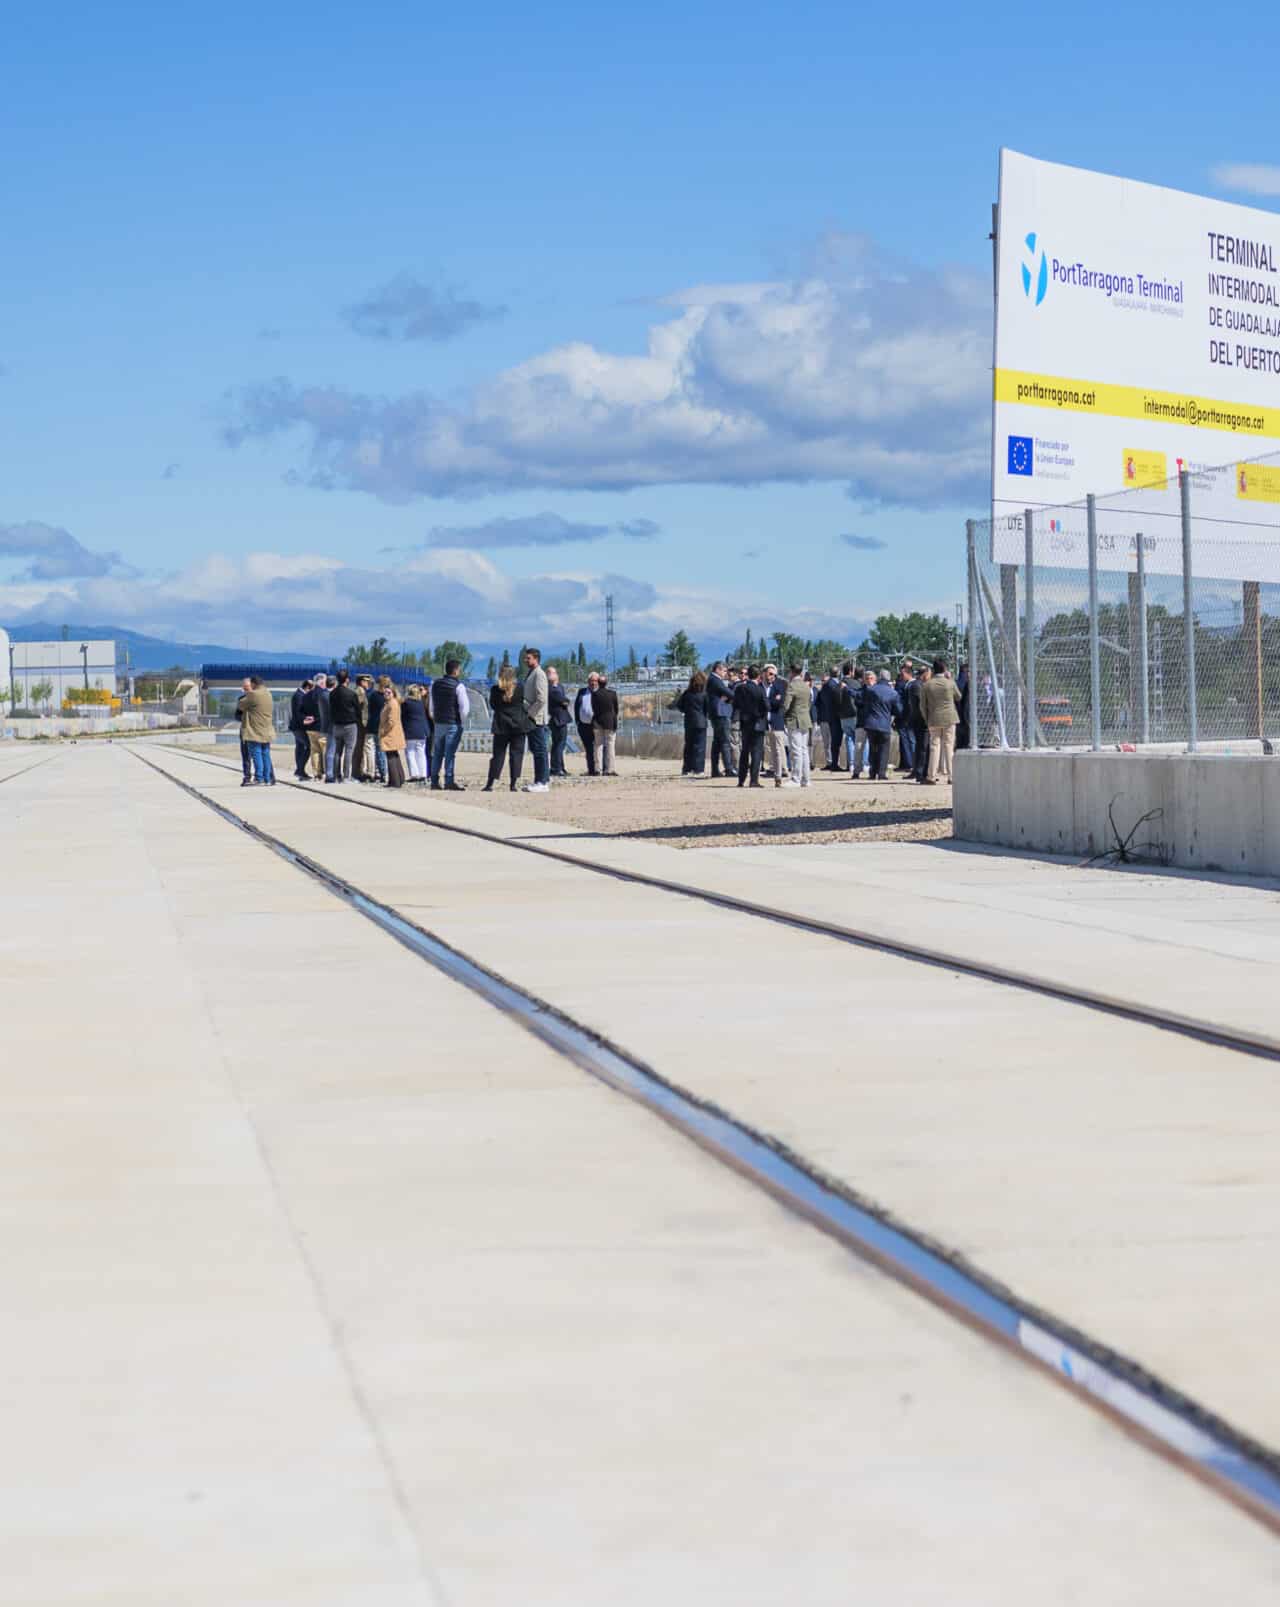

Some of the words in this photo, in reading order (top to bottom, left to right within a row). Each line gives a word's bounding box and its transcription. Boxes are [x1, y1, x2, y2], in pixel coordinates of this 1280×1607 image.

[1208, 232, 1277, 273] TERMINAL
[1052, 258, 1134, 297] PortTarragona
[1137, 274, 1184, 304] Terminal
[1208, 273, 1279, 307] INTERMODAL
[1209, 307, 1224, 327] DE
[1210, 340, 1233, 366] DEL
[1017, 382, 1096, 409] porttarragona.cat
[1143, 395, 1265, 432] intermodal@porttarragona.cat
[1007, 517, 1023, 531] UTE
